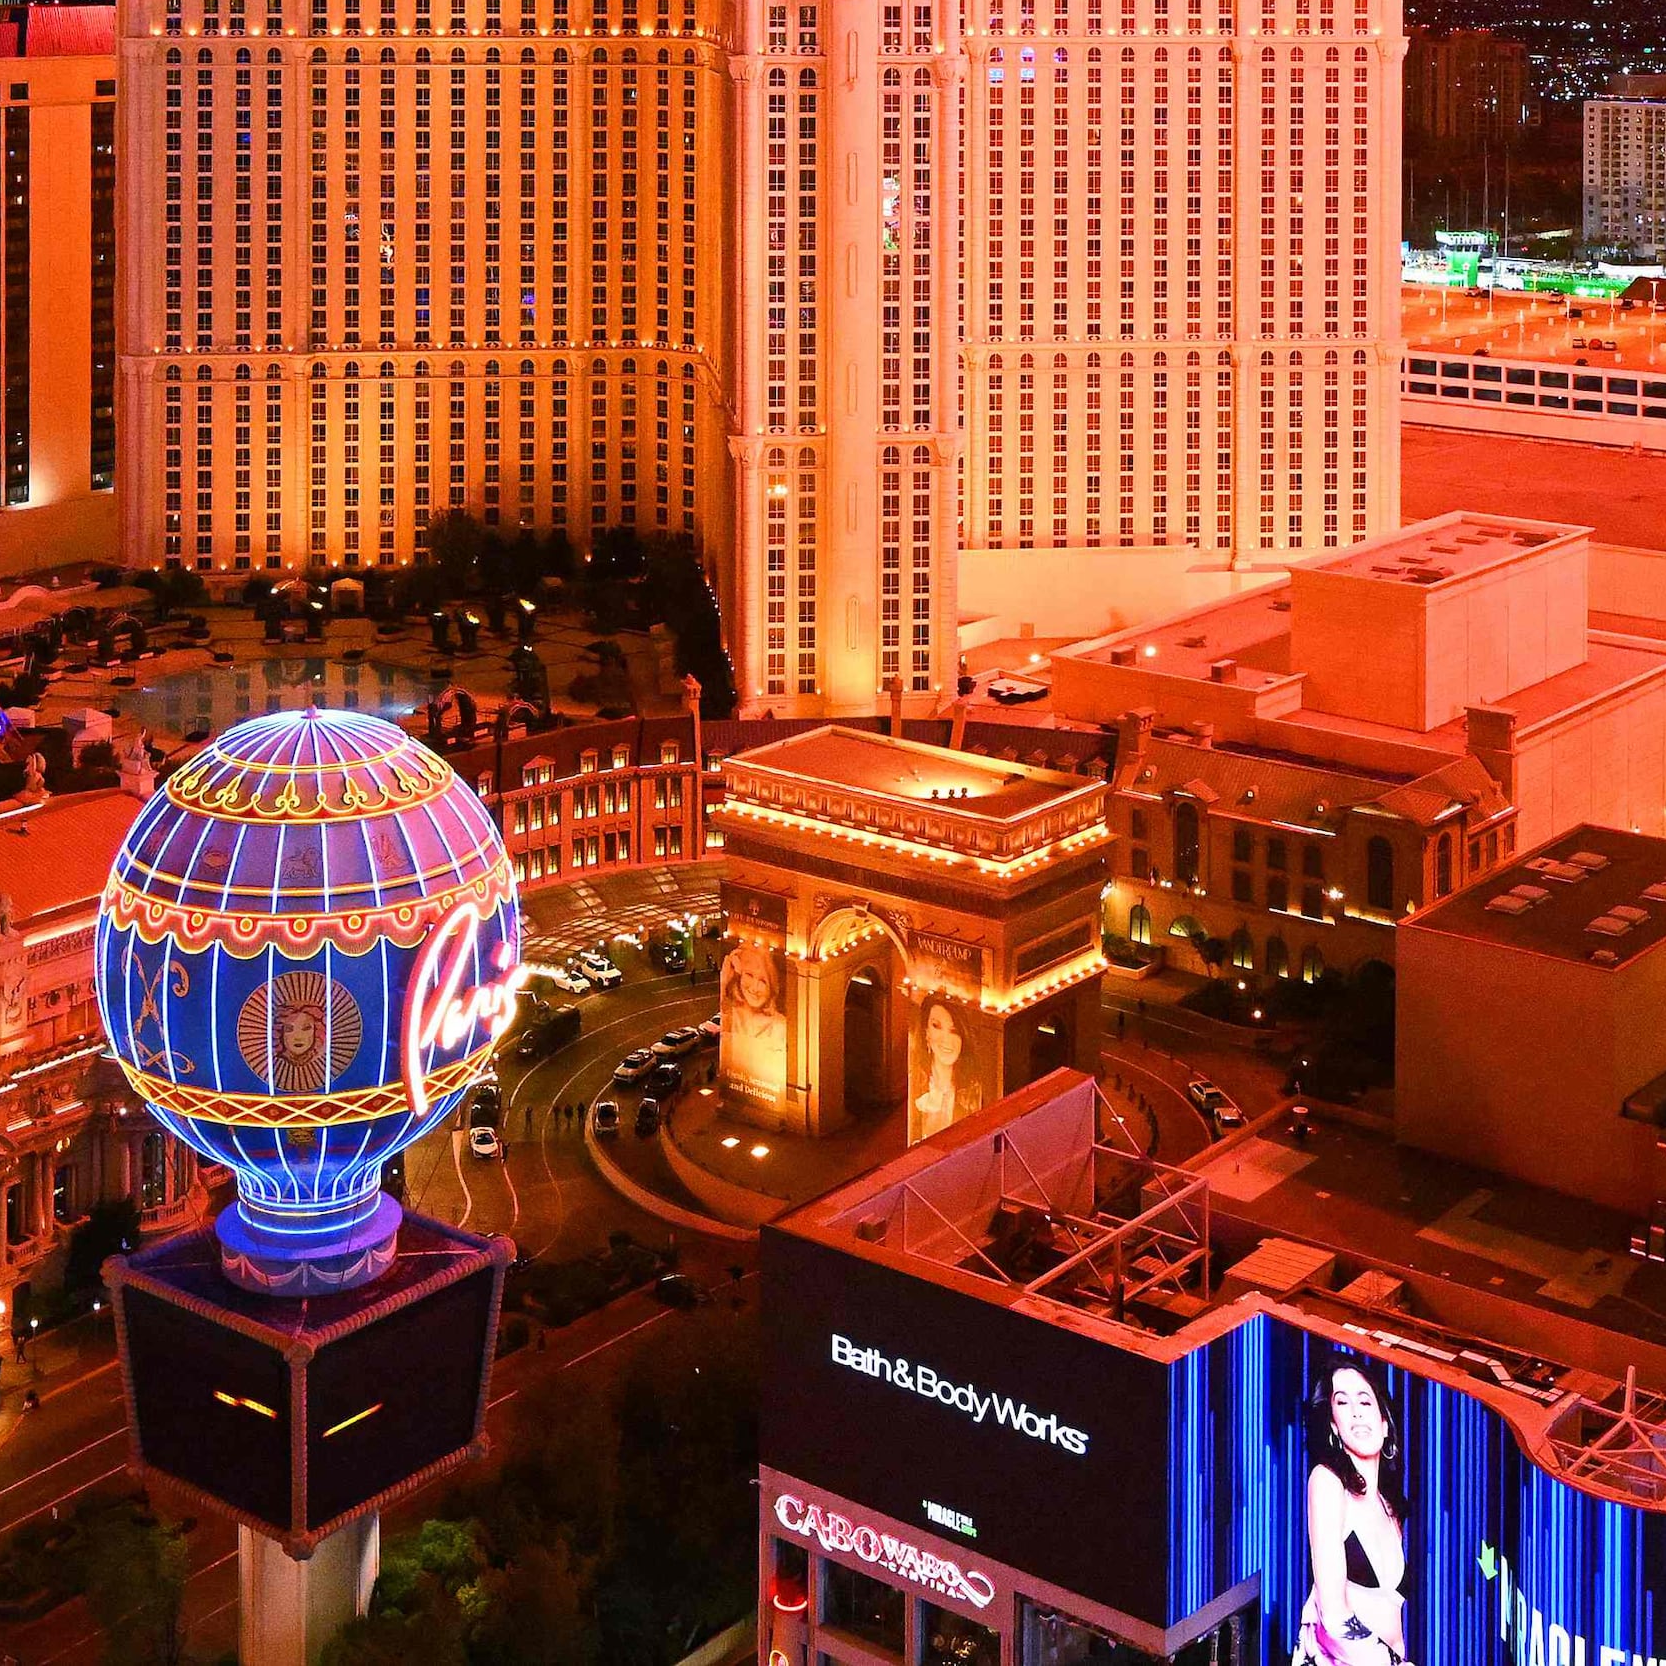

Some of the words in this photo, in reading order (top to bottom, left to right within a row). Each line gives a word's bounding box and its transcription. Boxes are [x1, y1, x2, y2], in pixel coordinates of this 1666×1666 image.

[403, 901, 567, 1117] Paris
[745, 1085, 776, 1102] Delicious
[832, 1334, 891, 1382] Bath
[892, 1358, 917, 1391] &
[917, 1365, 990, 1423] Body
[991, 1393, 1089, 1455] Works
[774, 1494, 883, 1562] CABO
